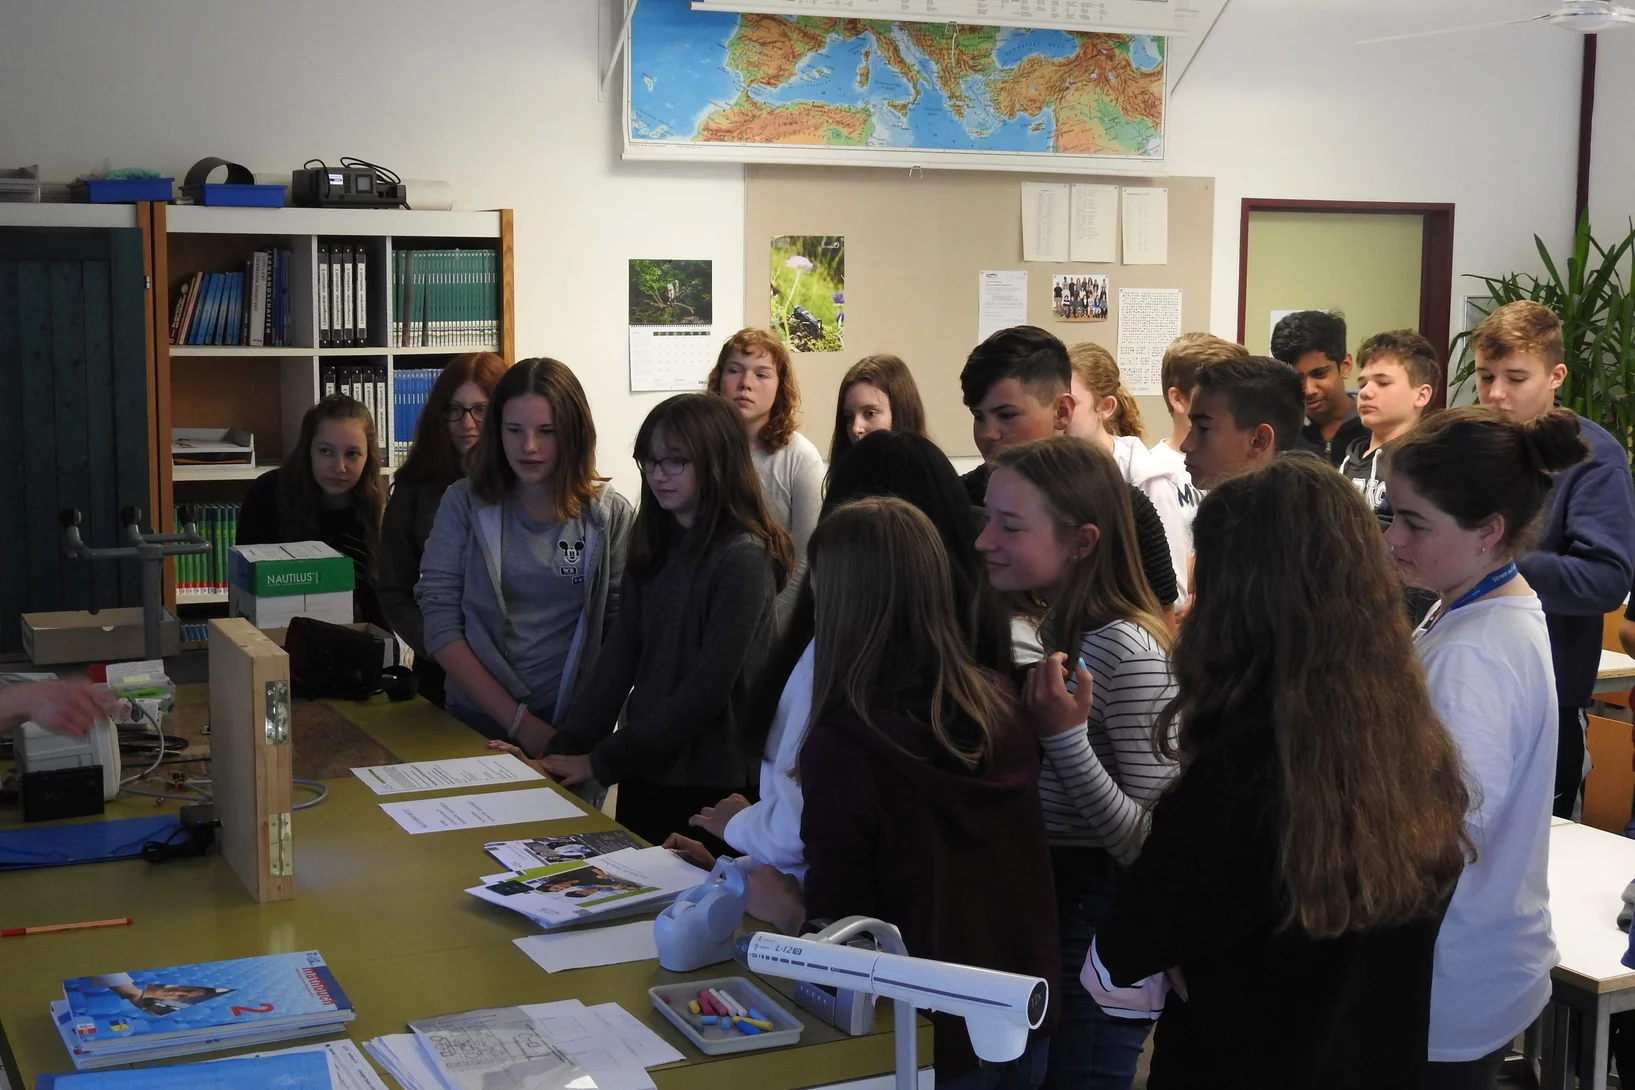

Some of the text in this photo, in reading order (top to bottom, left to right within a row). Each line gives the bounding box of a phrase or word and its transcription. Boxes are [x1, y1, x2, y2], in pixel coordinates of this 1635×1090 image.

[267, 572, 313, 584] NAUTILUS
[302, 967, 336, 1006] mathbuch
[230, 1003, 274, 1017] 2
